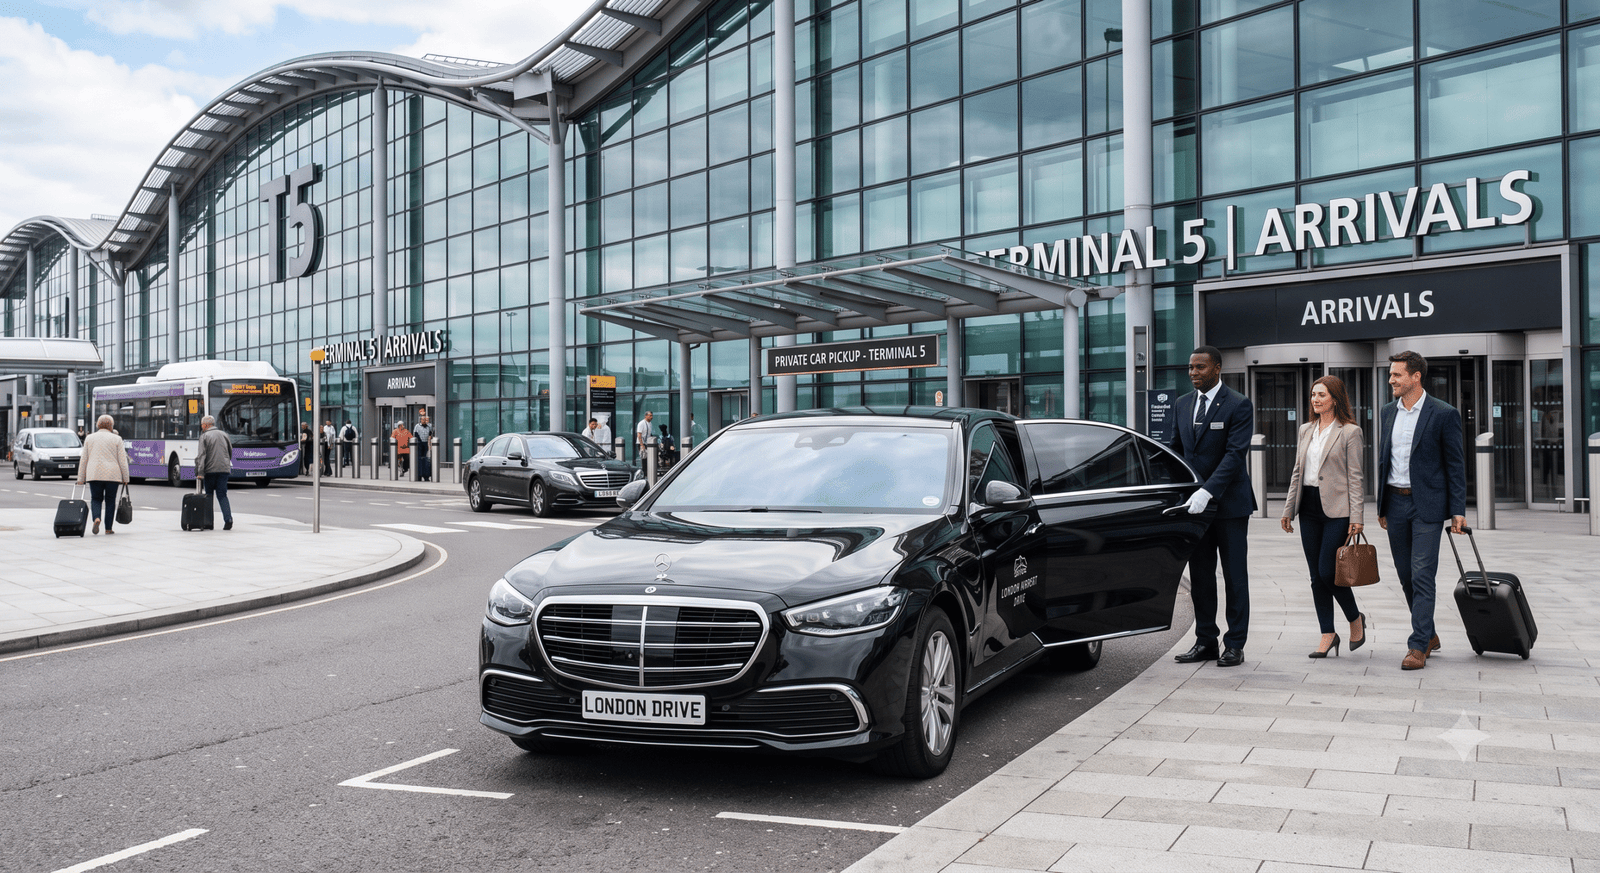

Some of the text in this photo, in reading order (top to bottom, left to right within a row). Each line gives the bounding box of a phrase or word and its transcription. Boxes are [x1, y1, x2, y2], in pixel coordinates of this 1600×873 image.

[260, 163, 317, 283] T5
[966, 225, 1168, 278] RMINAL
[1183, 218, 1207, 265] 5
[1255, 170, 1534, 255] ARRIVALS
[1301, 290, 1435, 326] ARRIVALS
[369, 338, 377, 360] 5
[384, 329, 442, 358] ARRIVALS
[775, 354, 808, 367] PRIVATE
[810, 352, 826, 365] CAR
[828, 350, 861, 363] PICKUP
[868, 346, 917, 361] TERMINAL
[920, 345, 926, 358] 5
[387, 376, 416, 390] ARRIVALS
[584, 696, 701, 719] LONDON DRIVE
